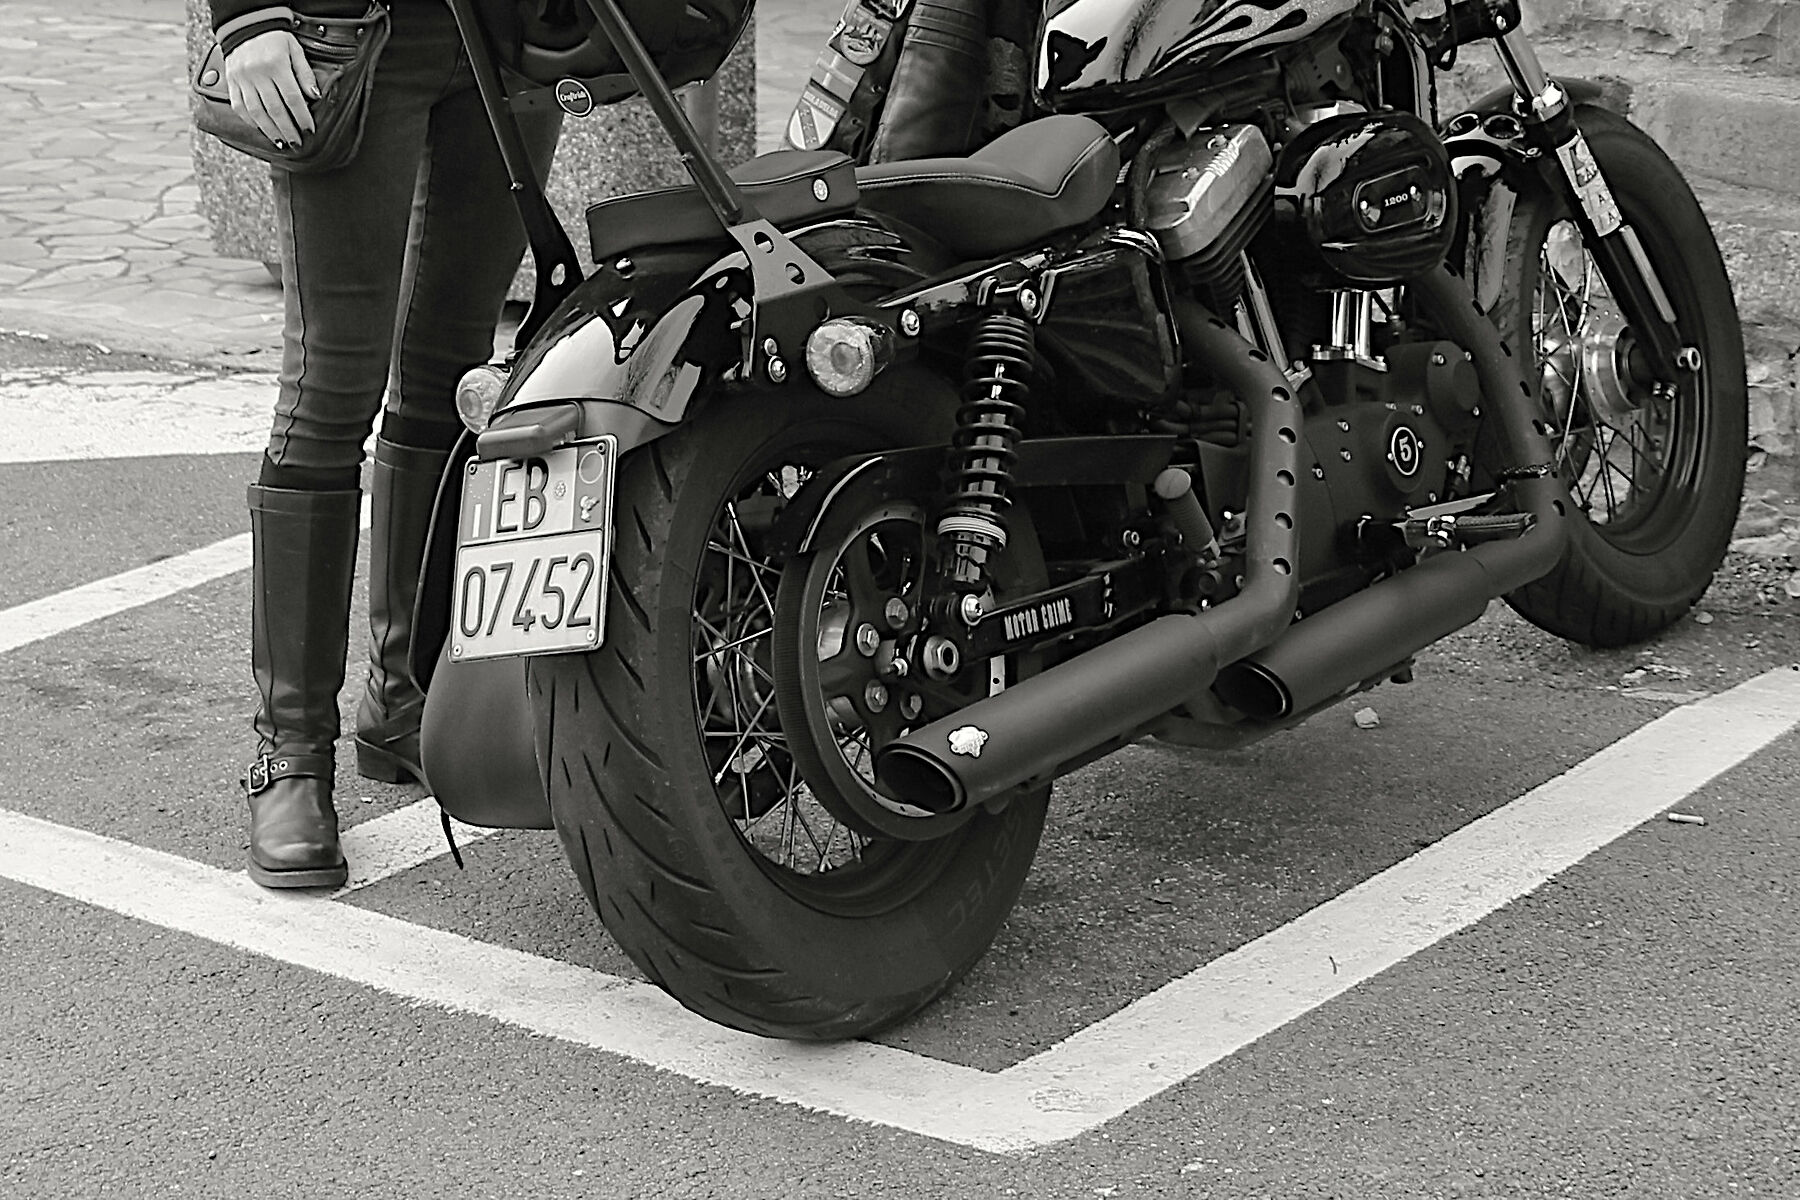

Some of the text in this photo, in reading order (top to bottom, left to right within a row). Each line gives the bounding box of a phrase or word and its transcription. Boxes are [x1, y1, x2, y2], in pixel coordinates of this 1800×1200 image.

[1384, 193, 1409, 208] 1200
[1399, 435, 1412, 462] 5
[496, 456, 549, 533] EB
[460, 552, 595, 638] 07452
[1004, 597, 1072, 641] MOTOR CRIME
